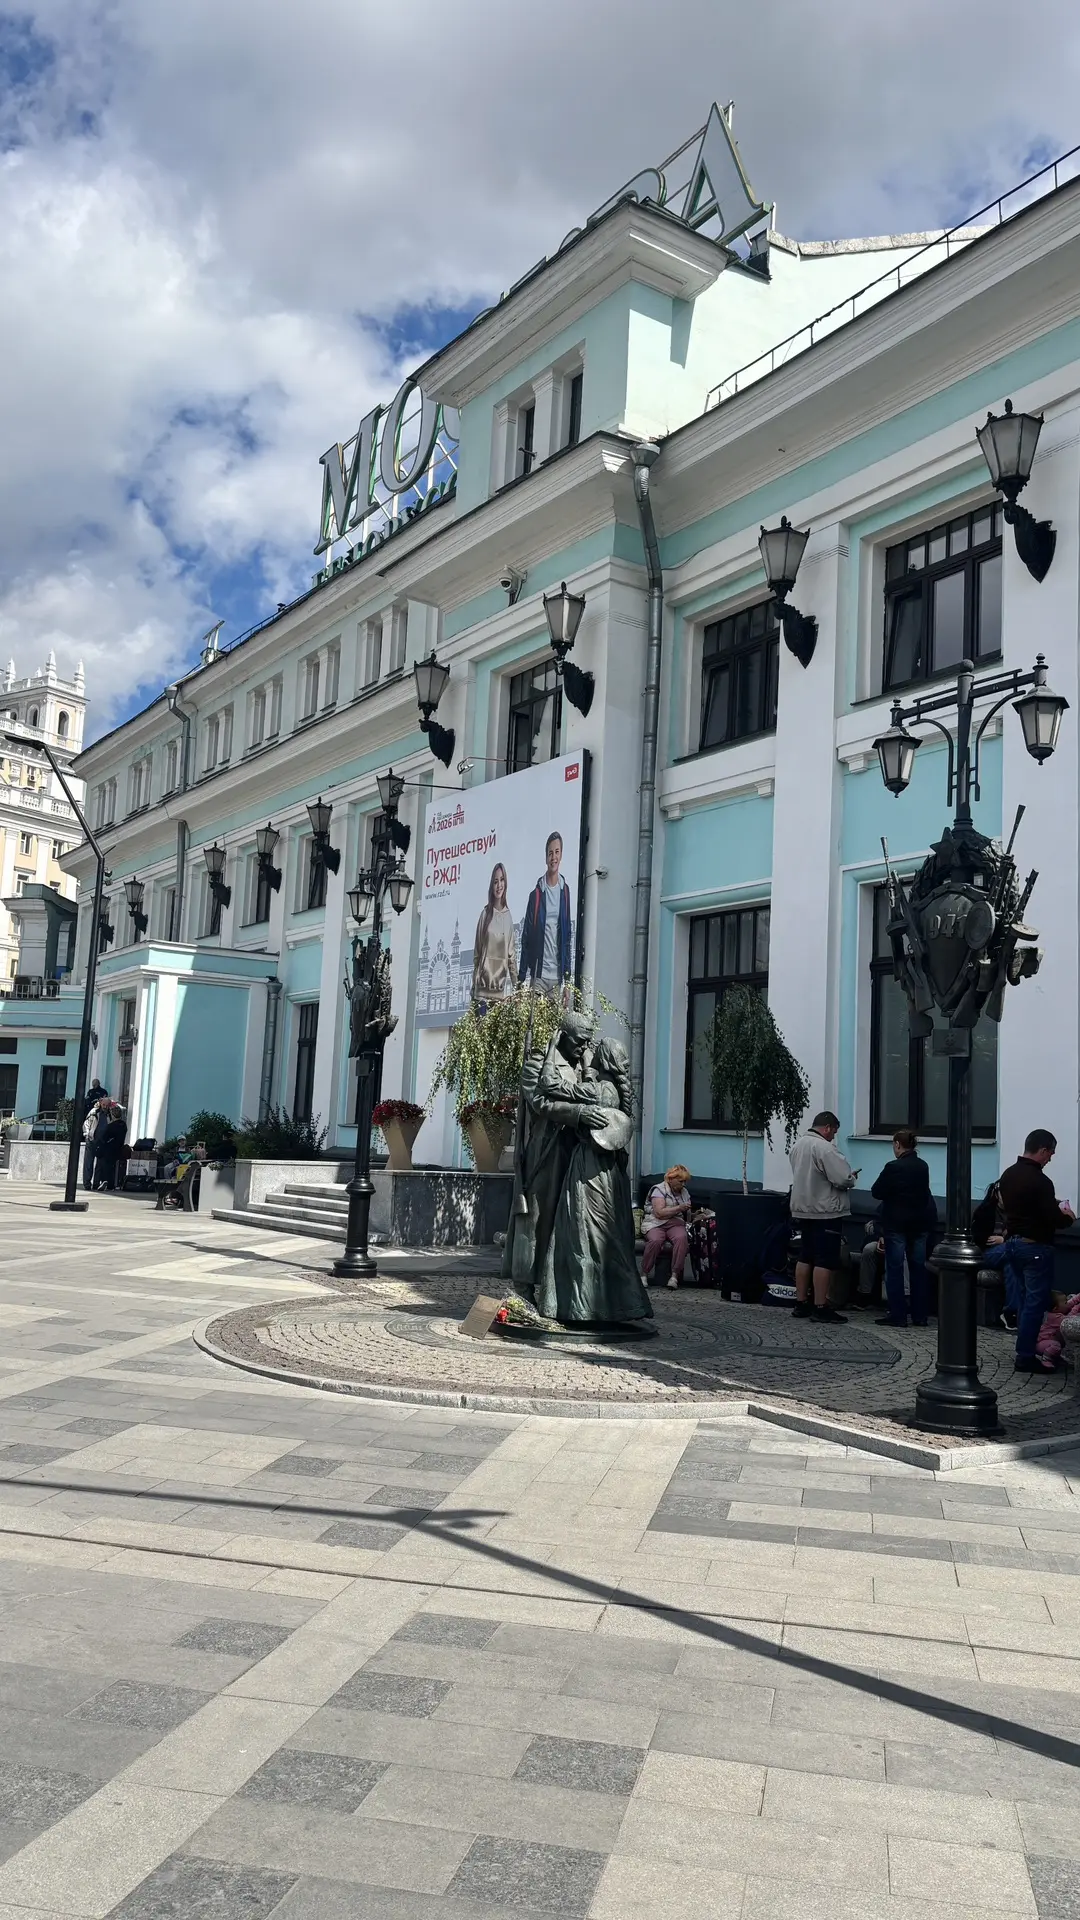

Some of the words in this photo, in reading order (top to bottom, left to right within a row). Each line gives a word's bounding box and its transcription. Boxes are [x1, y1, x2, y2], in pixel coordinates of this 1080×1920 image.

[436, 817, 452, 832] 2026
[426, 828, 497, 868] Путешествуй
[433, 863, 461, 886] РЖД!
